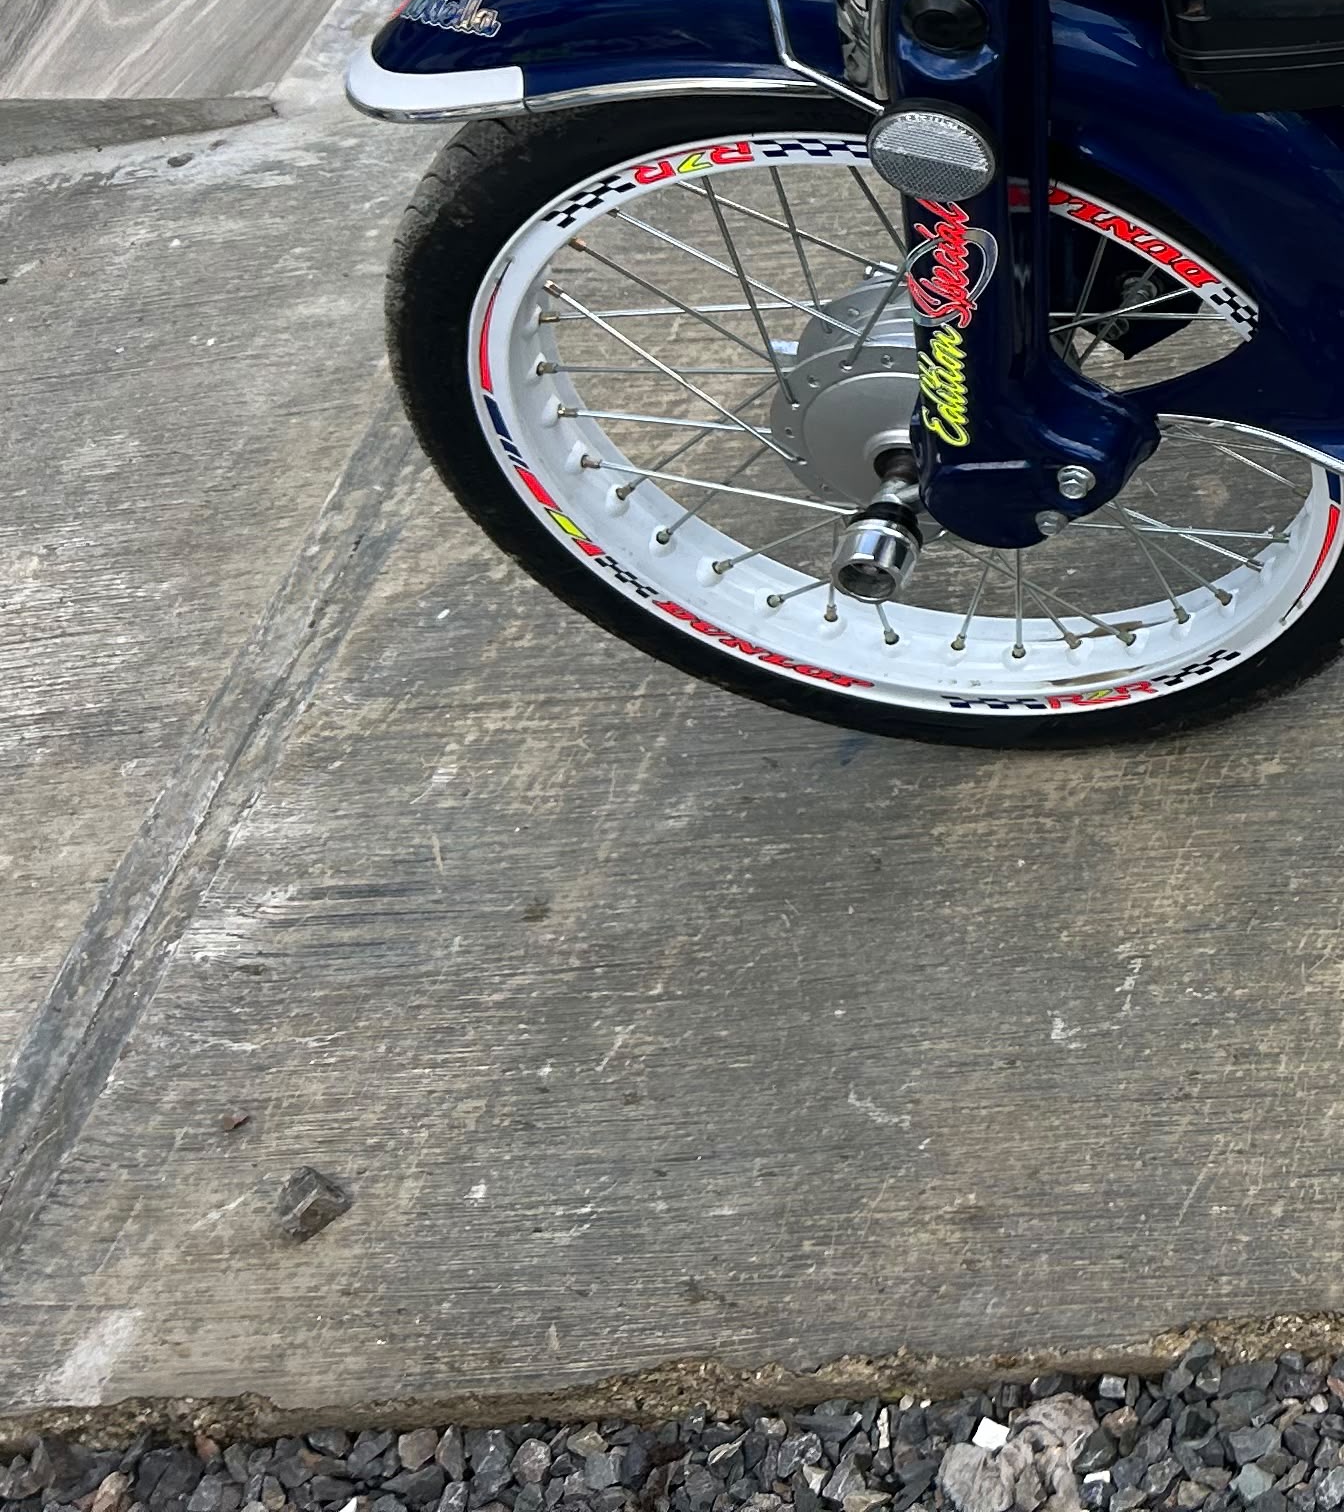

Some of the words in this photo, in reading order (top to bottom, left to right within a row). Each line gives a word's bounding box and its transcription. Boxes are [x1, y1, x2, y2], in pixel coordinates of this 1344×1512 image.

[906, 196, 972, 329] Special
[1047, 186, 1223, 289] DUNLO
[926, 324, 972, 449] Edition
[651, 598, 876, 689] DUNLOP
